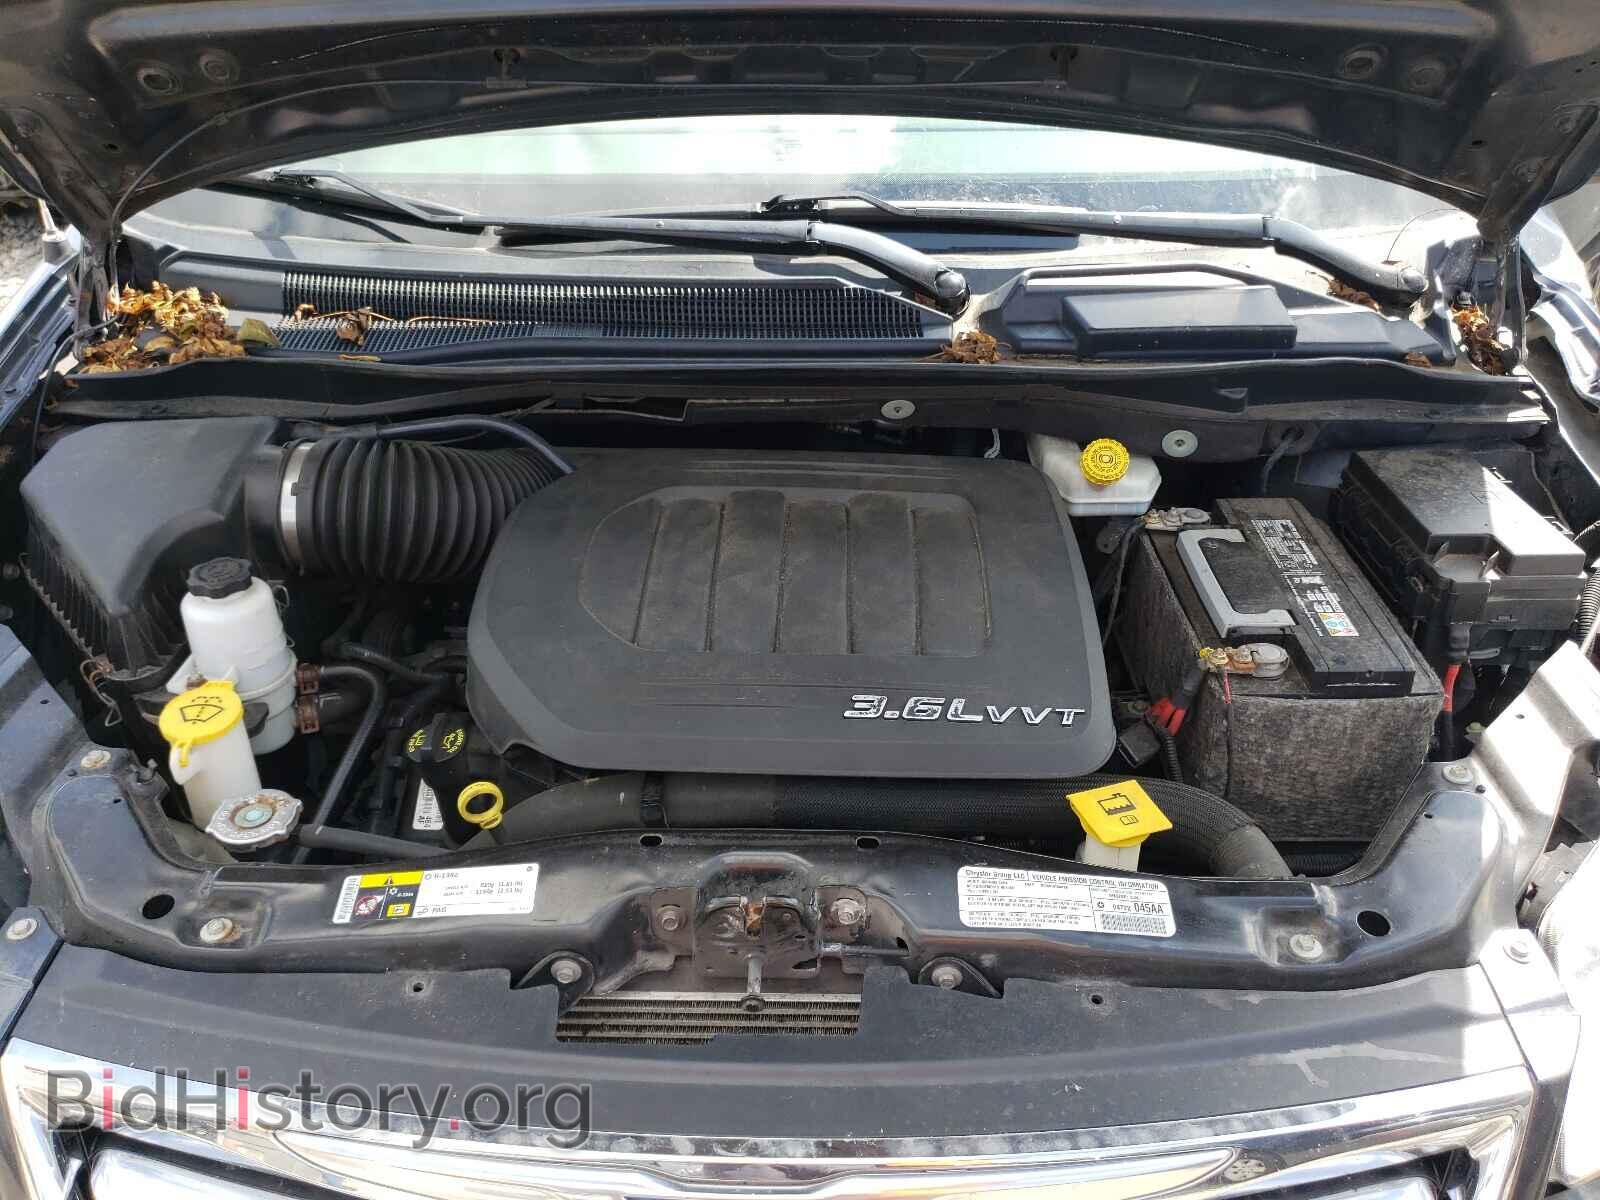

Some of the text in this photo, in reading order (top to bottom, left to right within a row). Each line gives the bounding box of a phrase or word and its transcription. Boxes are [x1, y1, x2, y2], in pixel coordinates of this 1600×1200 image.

[1031, 873, 1057, 882] VEHICLE
[1089, 878, 1116, 887] CONTROL
[1117, 880, 1160, 889] INFORMATION
